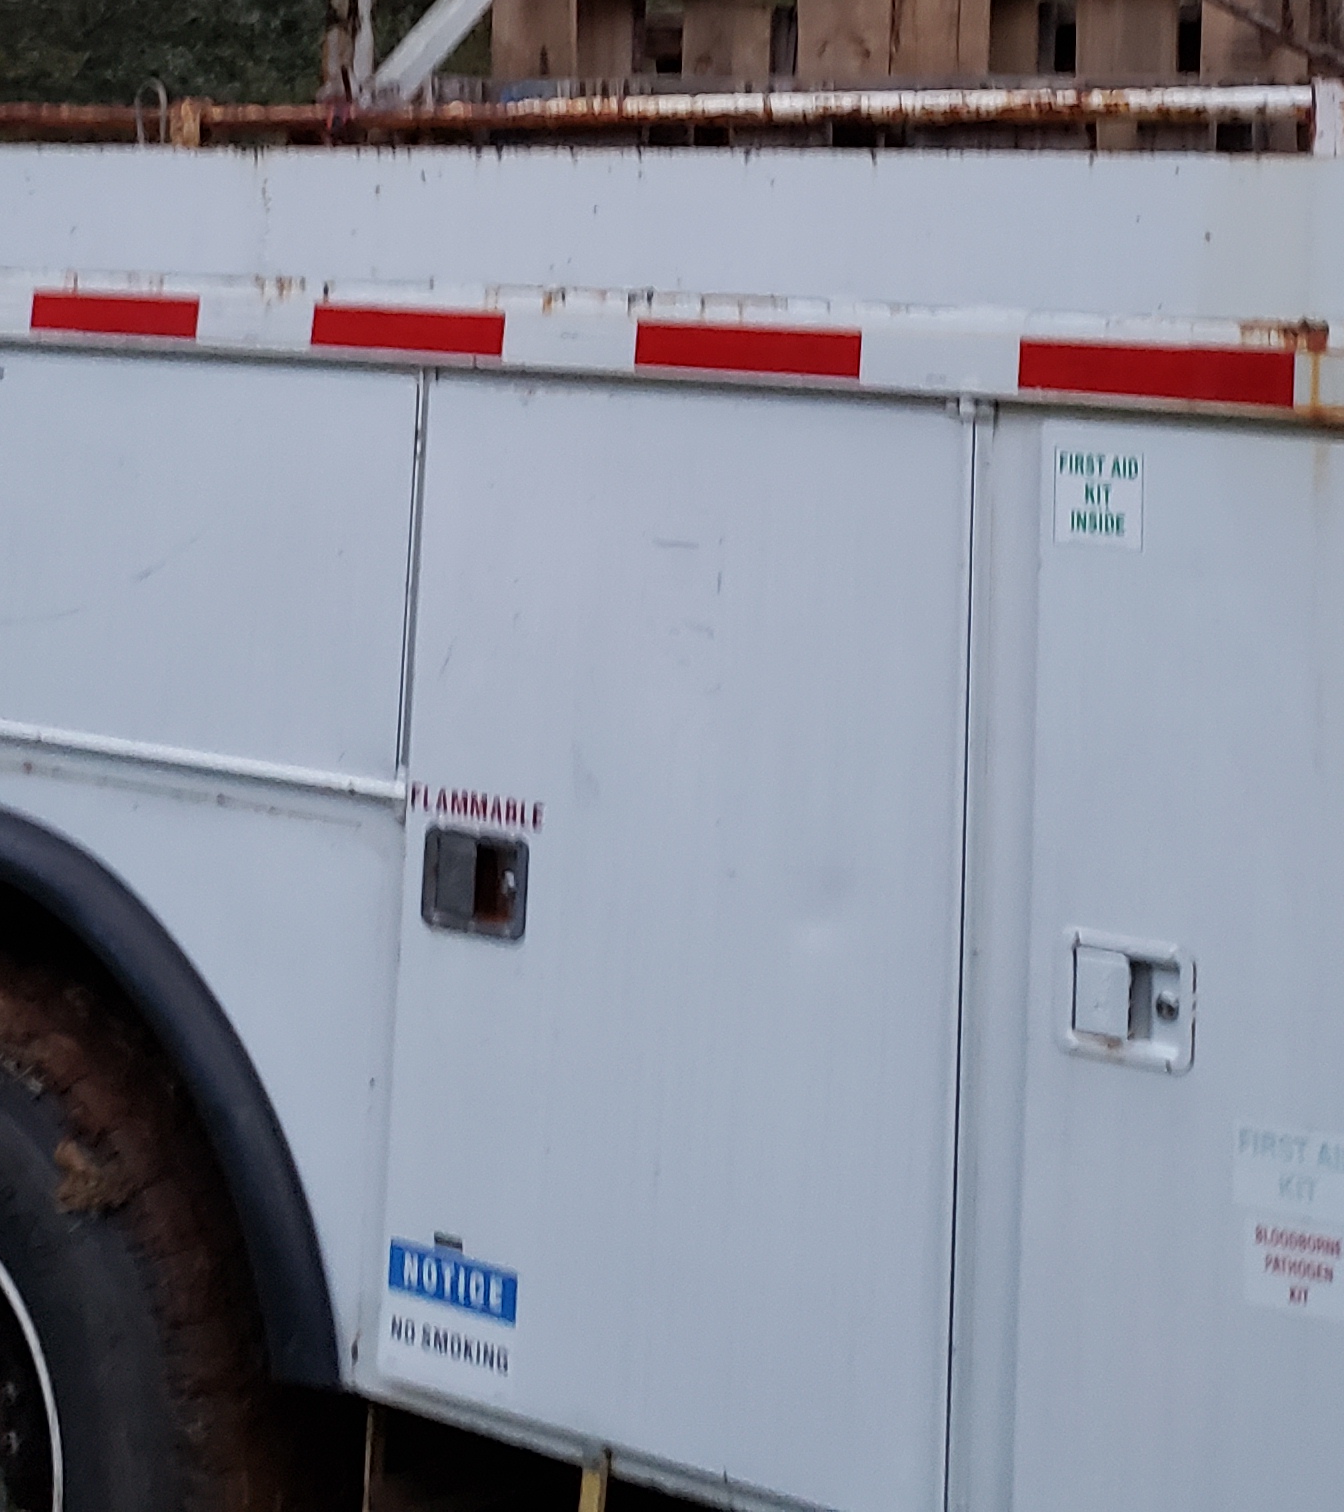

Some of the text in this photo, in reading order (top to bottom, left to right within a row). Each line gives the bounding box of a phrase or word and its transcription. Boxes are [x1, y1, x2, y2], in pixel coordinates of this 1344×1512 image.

[1058, 451, 1139, 480] FIRST AID
[1084, 482, 1111, 507] KIT
[1070, 509, 1125, 537] INSIDE
[410, 781, 544, 834] FLAMMABLE
[404, 1251, 504, 1315] NOTICE
[391, 1314, 509, 1377] NO SMOKING
